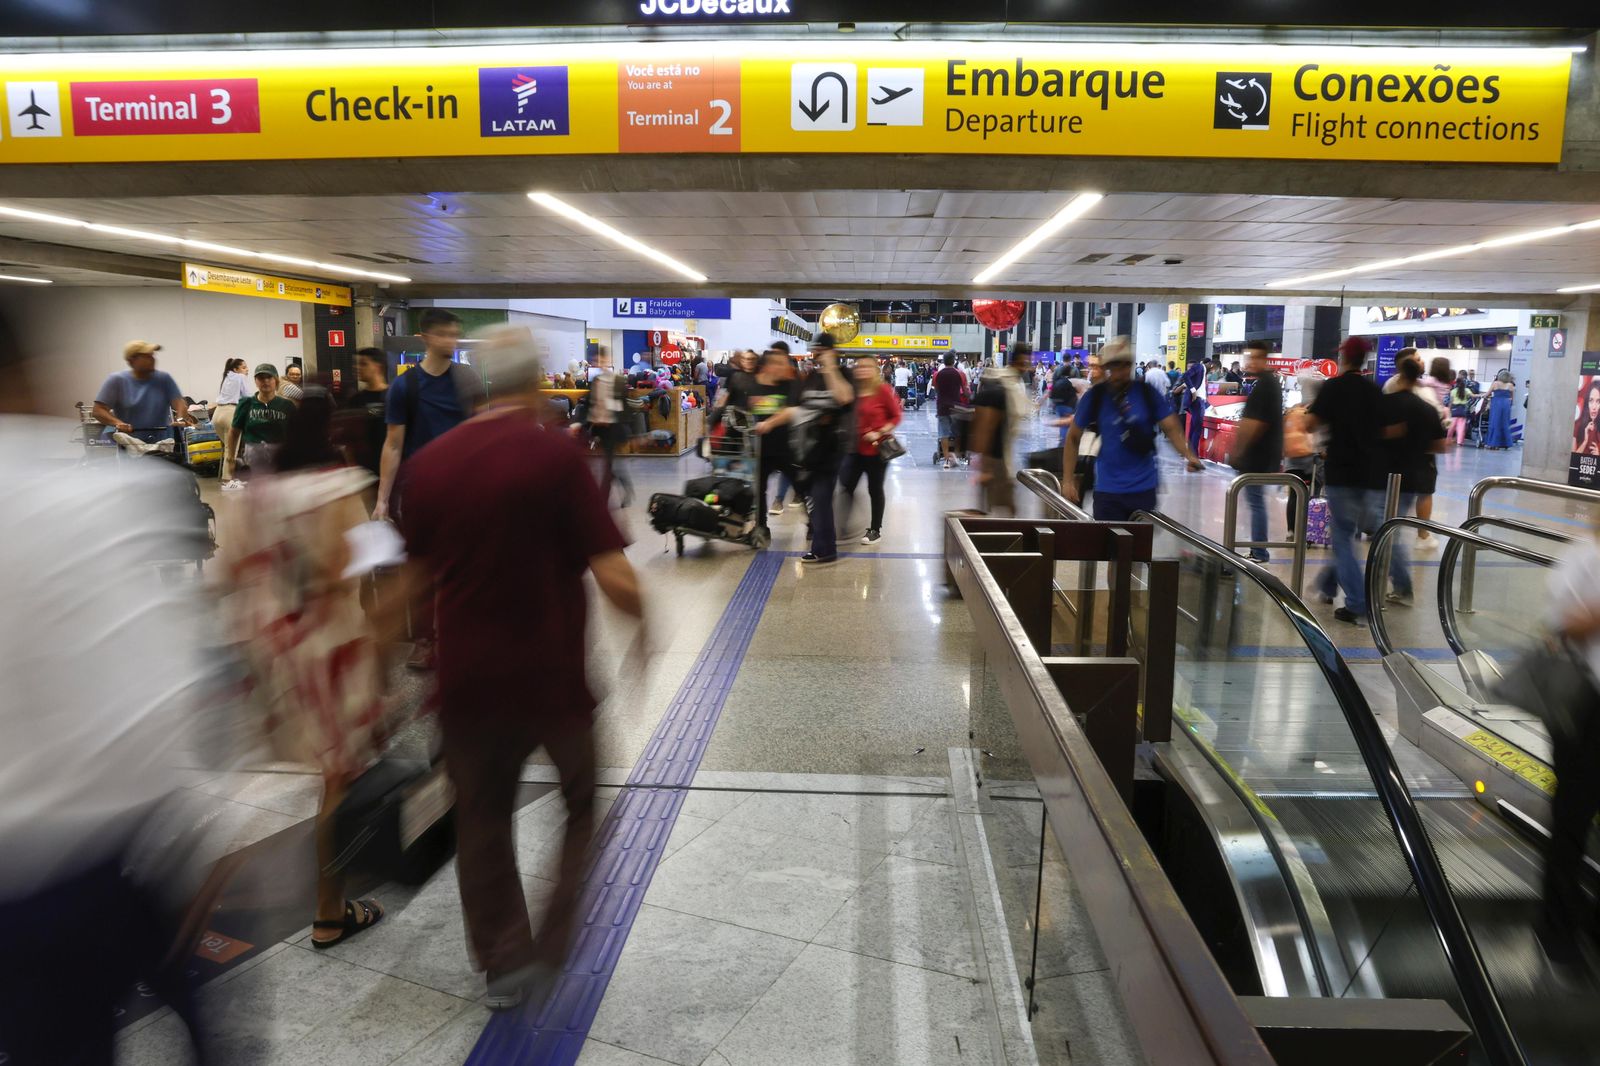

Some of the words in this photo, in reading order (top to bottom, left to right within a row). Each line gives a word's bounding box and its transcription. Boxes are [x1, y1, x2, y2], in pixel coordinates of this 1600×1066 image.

[640, 0, 791, 15] JCDecaux
[626, 64, 653, 76] Você
[657, 63, 681, 76] está
[685, 67, 700, 76] no
[628, 80, 645, 90] You
[646, 82, 663, 90] are
[664, 81, 673, 90] at
[947, 57, 1165, 110] Embarque
[1294, 64, 1500, 104] Conexões
[85, 92, 197, 121] Terminal
[210, 88, 233, 125] 3
[305, 85, 459, 122] Check-in
[627, 110, 699, 127] Terminal
[709, 99, 733, 135] 2
[946, 108, 1083, 140] Departure
[492, 119, 556, 132] LATAM
[1292, 113, 1368, 146] Flight
[1375, 116, 1540, 141] connections
[649, 299, 682, 307] Fraldário
[649, 308, 667, 317] Baby
[668, 308, 695, 317] change
[660, 350, 681, 359] FOM
[1580, 456, 1593, 466] BATEU
[1579, 465, 1596, 475] SEDE?
